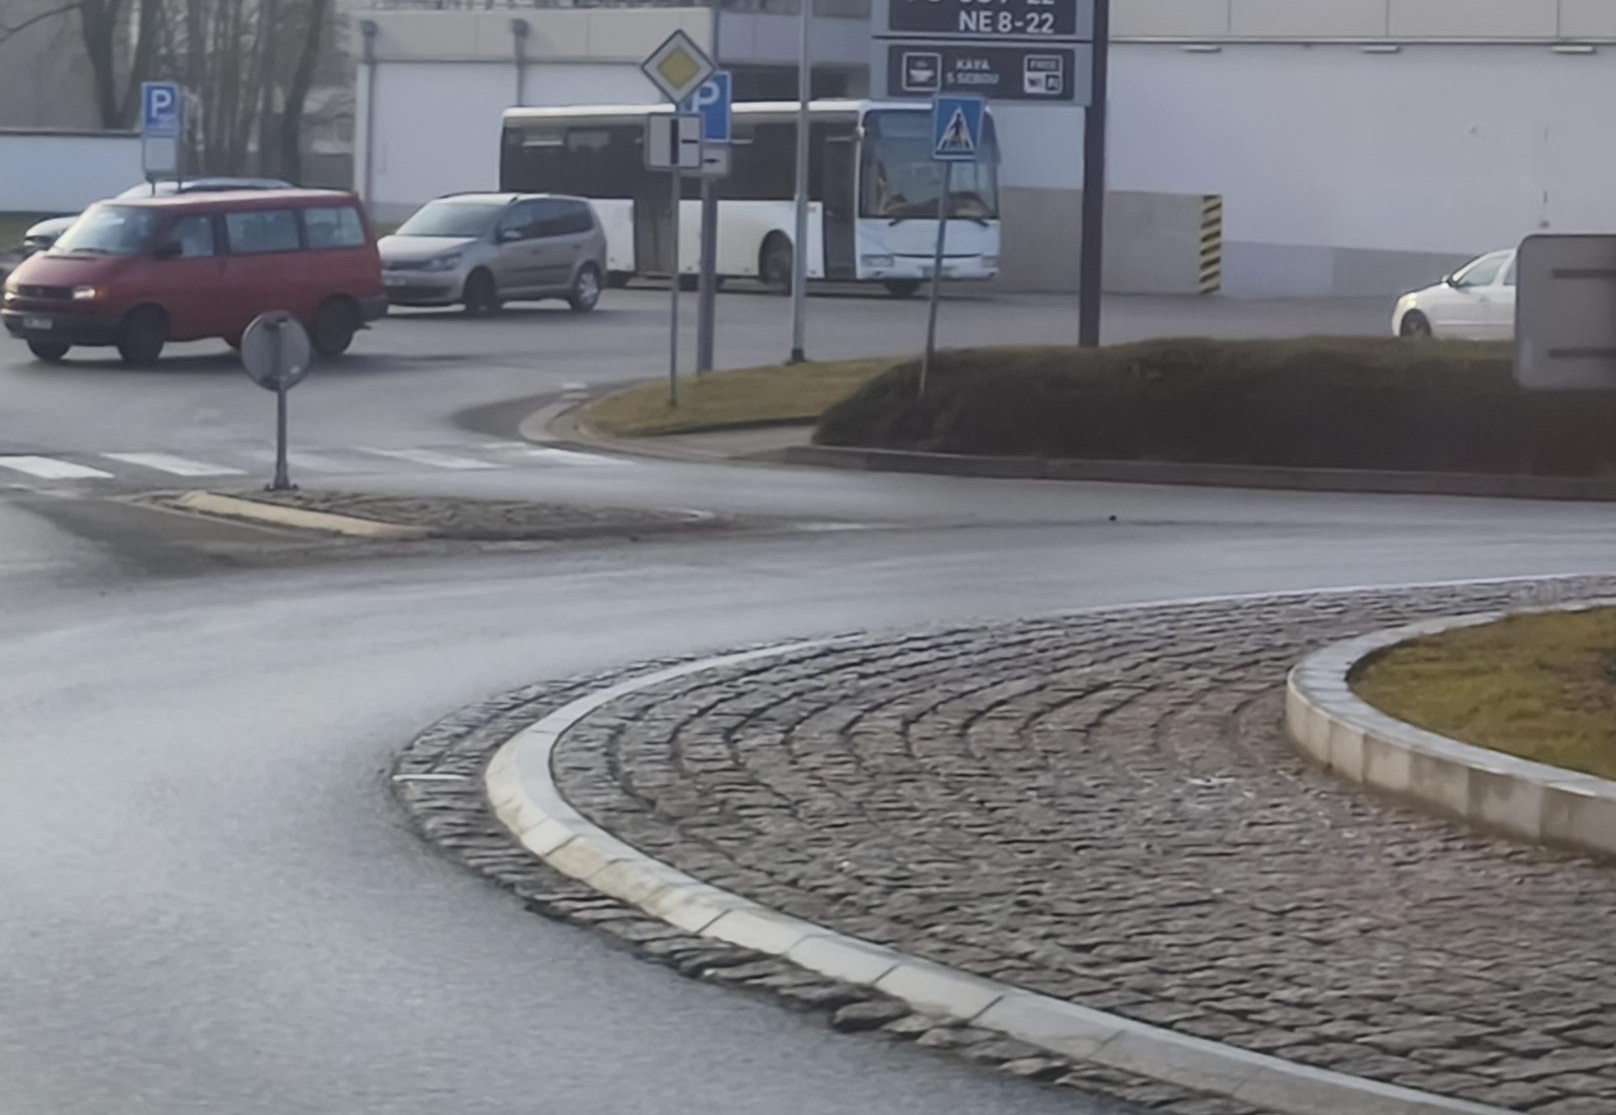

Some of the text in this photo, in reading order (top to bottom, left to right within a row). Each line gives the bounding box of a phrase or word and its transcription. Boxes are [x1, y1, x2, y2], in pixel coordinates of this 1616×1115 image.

[959, 10, 1055, 34] NE 8-22
[151, 89, 172, 118] P
